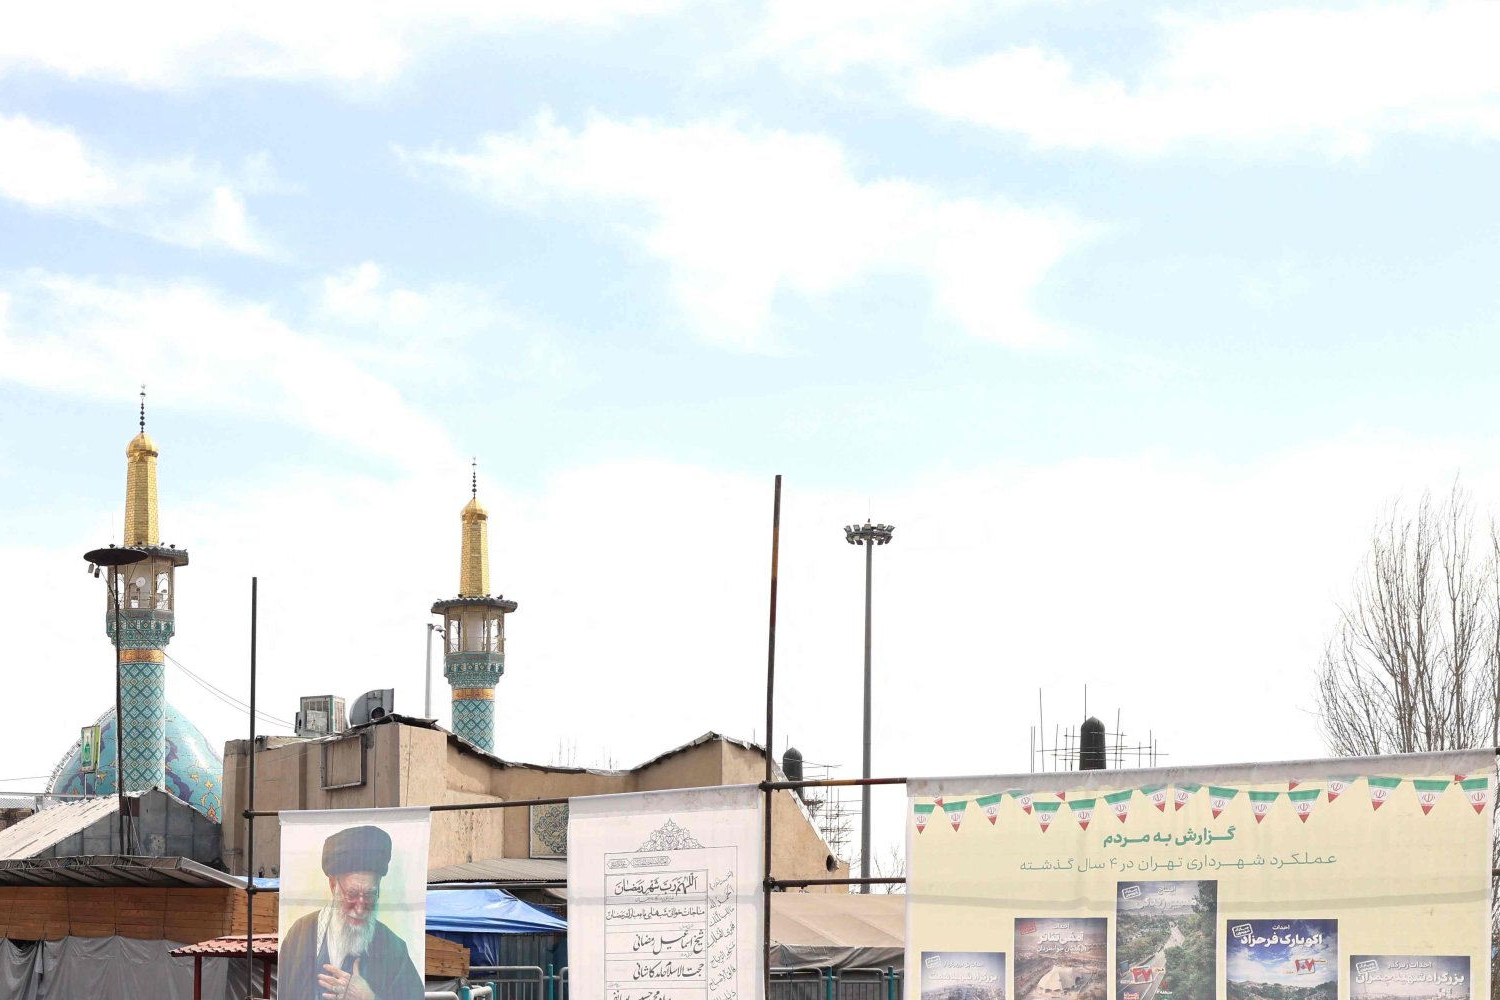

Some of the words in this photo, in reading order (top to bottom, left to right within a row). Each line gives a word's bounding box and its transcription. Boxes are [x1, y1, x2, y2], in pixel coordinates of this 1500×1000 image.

[1102, 832, 1150, 848] مردم
[1152, 832, 1172, 846] به
[1175, 826, 1236, 847] گزارش
[1019, 858, 1075, 871] گذشته
[1076, 858, 1106, 872] سال
[1119, 860, 1134, 872] در
[1137, 856, 1183, 871] تهران
[1186, 854, 1266, 871] شهرداری
[1269, 852, 1338, 869] عملکرد
[693, 929, 704, 955] شیخ
[1241, 932, 1279, 948] فرحزاد
